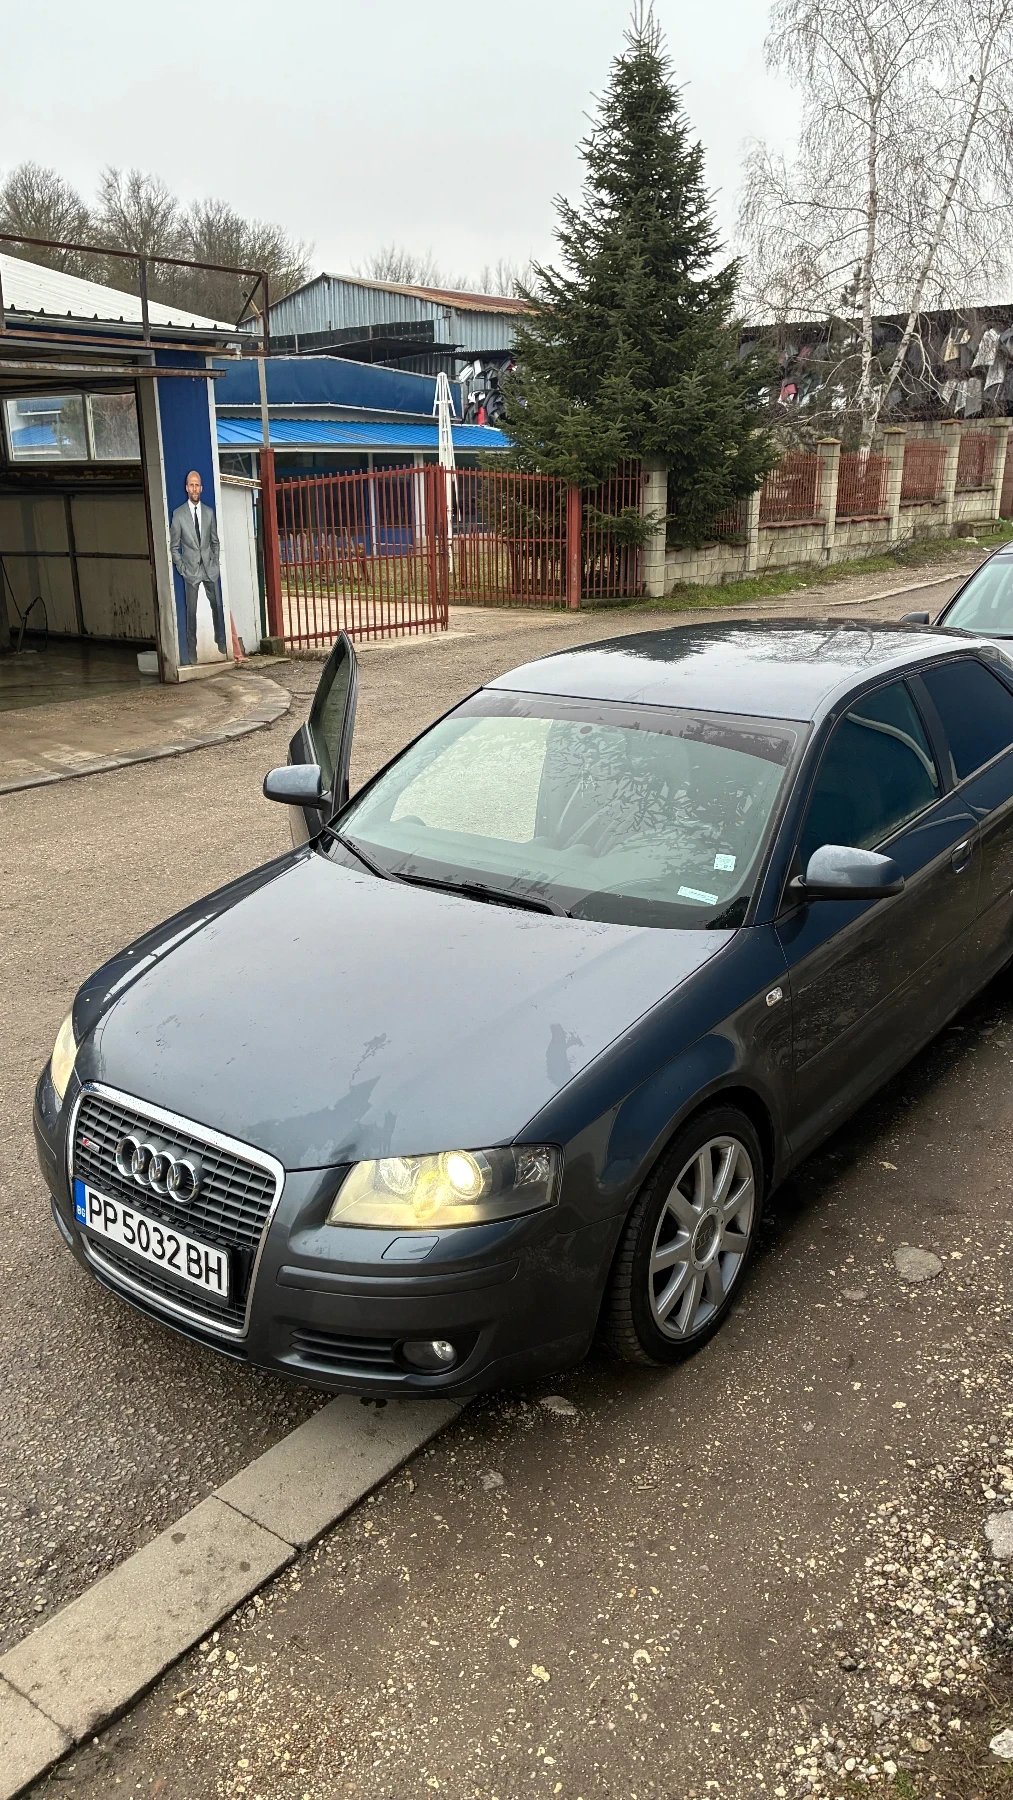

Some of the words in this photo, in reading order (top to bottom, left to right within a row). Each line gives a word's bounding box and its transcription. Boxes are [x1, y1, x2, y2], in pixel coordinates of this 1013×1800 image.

[76, 1204, 86, 1218] BG
[88, 1191, 118, 1232] PP
[122, 1209, 182, 1271] 5032
[186, 1242, 222, 1290] BH
